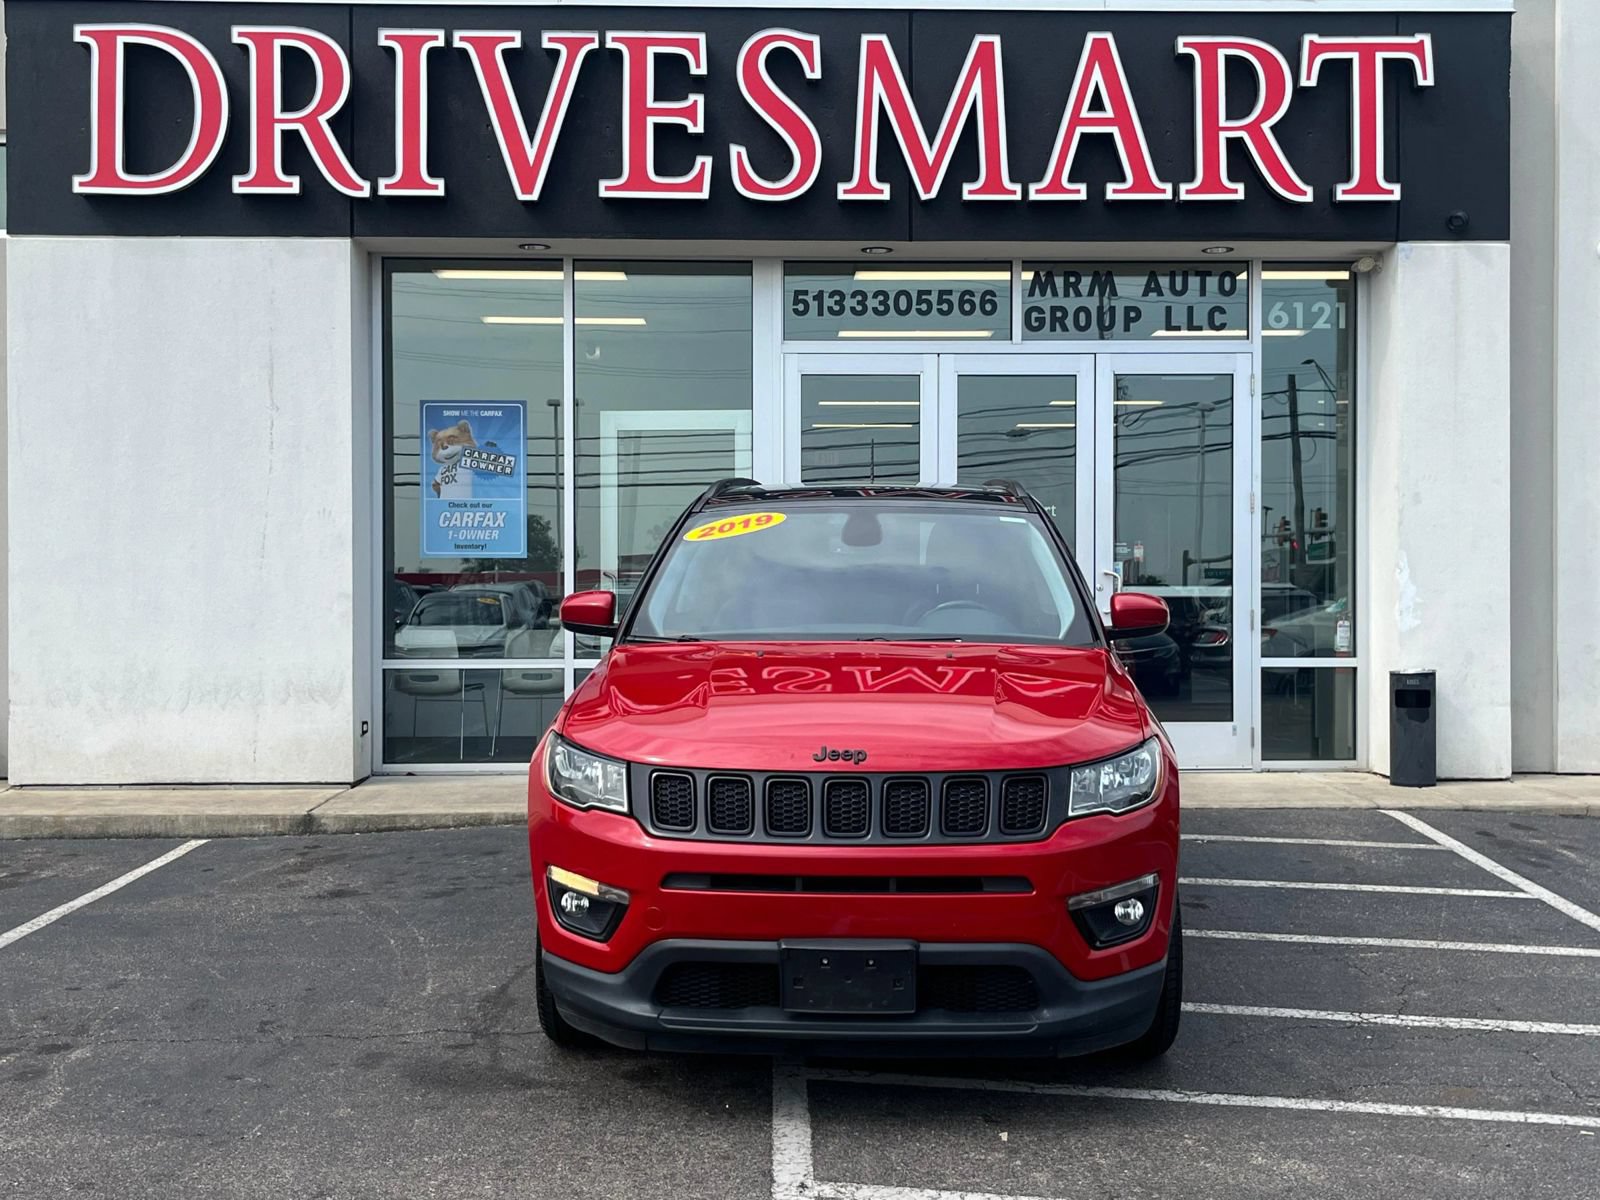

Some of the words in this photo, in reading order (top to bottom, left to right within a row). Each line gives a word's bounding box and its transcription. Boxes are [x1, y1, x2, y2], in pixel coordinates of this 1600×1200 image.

[73, 23, 1436, 203] DRIVESMART
[1027, 270, 1119, 298] MRM
[1141, 270, 1238, 298] AUTO
[792, 289, 998, 317] 5133305566
[1023, 305, 1142, 333] GROUP
[1164, 305, 1228, 332] LLC
[1267, 301, 1347, 329] 6121
[464, 449, 514, 467] CARFAX
[441, 463, 458, 475] CAR
[441, 473, 458, 485] FOX
[439, 511, 507, 528] CARFAX
[697, 514, 773, 539] 2019
[448, 529, 500, 541] 1-OWNER
[454, 543, 487, 551] Inventory!
[812, 745, 868, 765] Jeep
